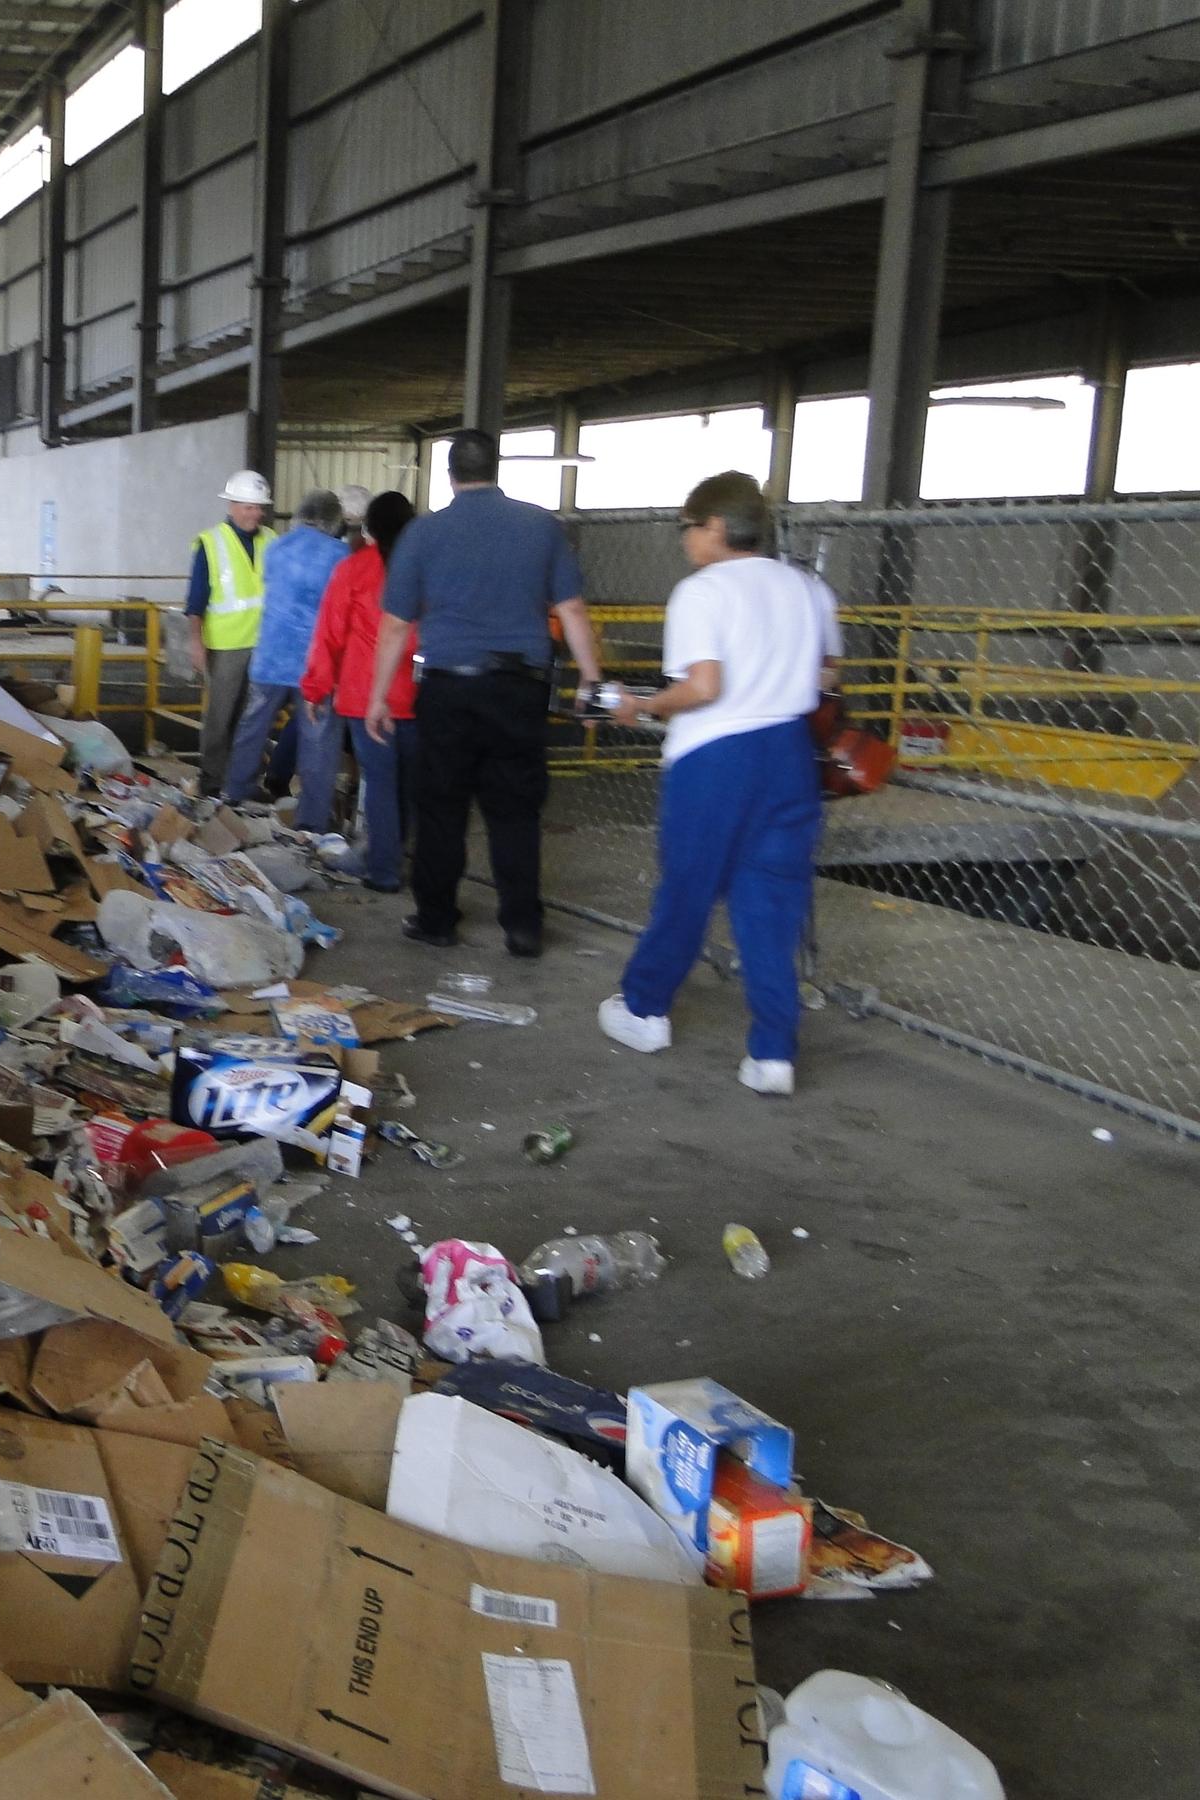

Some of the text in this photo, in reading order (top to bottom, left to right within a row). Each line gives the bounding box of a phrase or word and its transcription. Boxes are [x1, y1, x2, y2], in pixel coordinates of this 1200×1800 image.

[348, 1586, 386, 1696] THIS END UP
